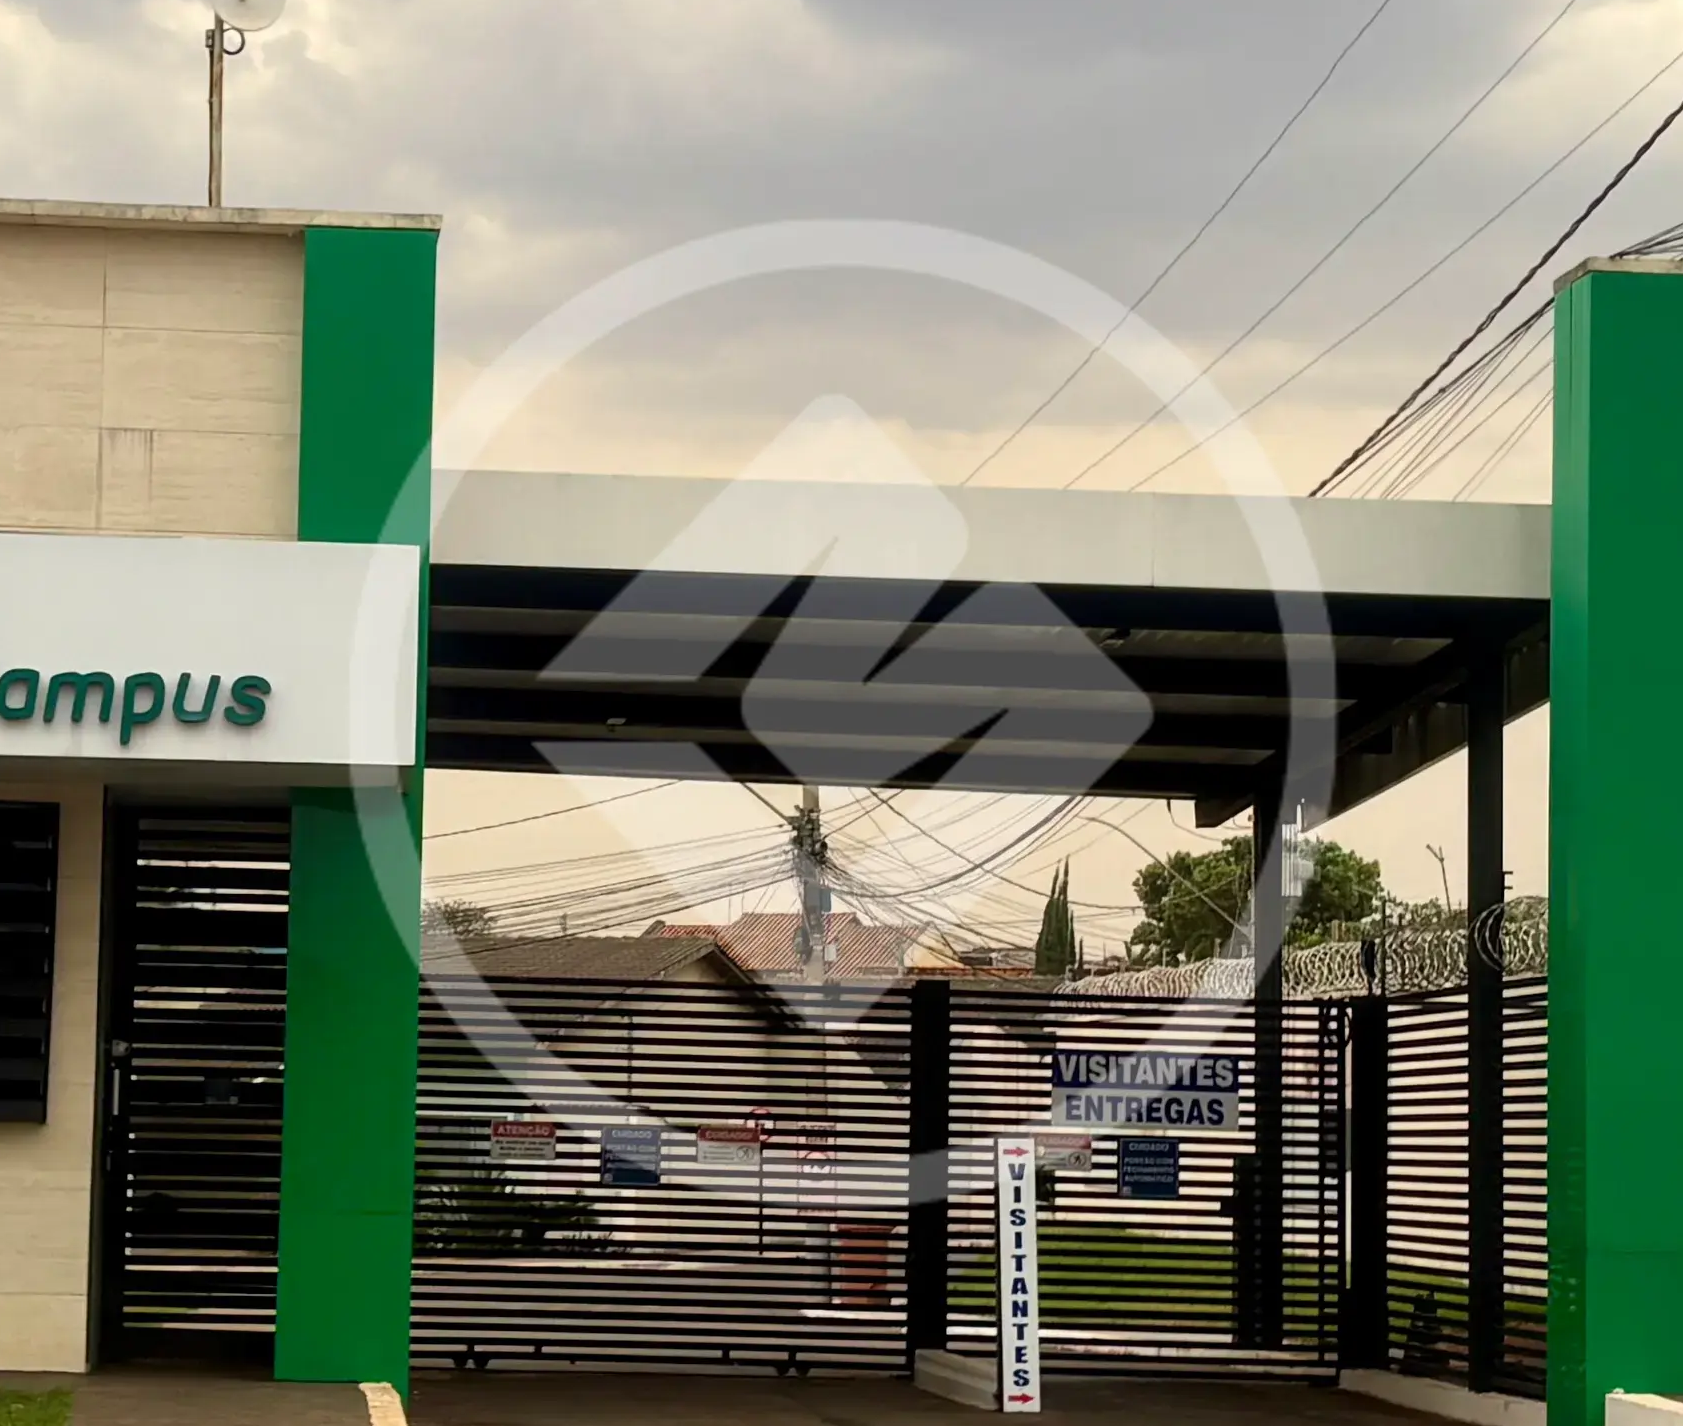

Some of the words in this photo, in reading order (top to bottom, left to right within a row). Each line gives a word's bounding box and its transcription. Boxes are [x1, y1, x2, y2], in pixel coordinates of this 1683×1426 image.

[1057, 1054, 1235, 1088] VISITANTES
[1065, 1094, 1226, 1126] ENTREGAS
[1007, 1163, 1030, 1387] VISITANTES
